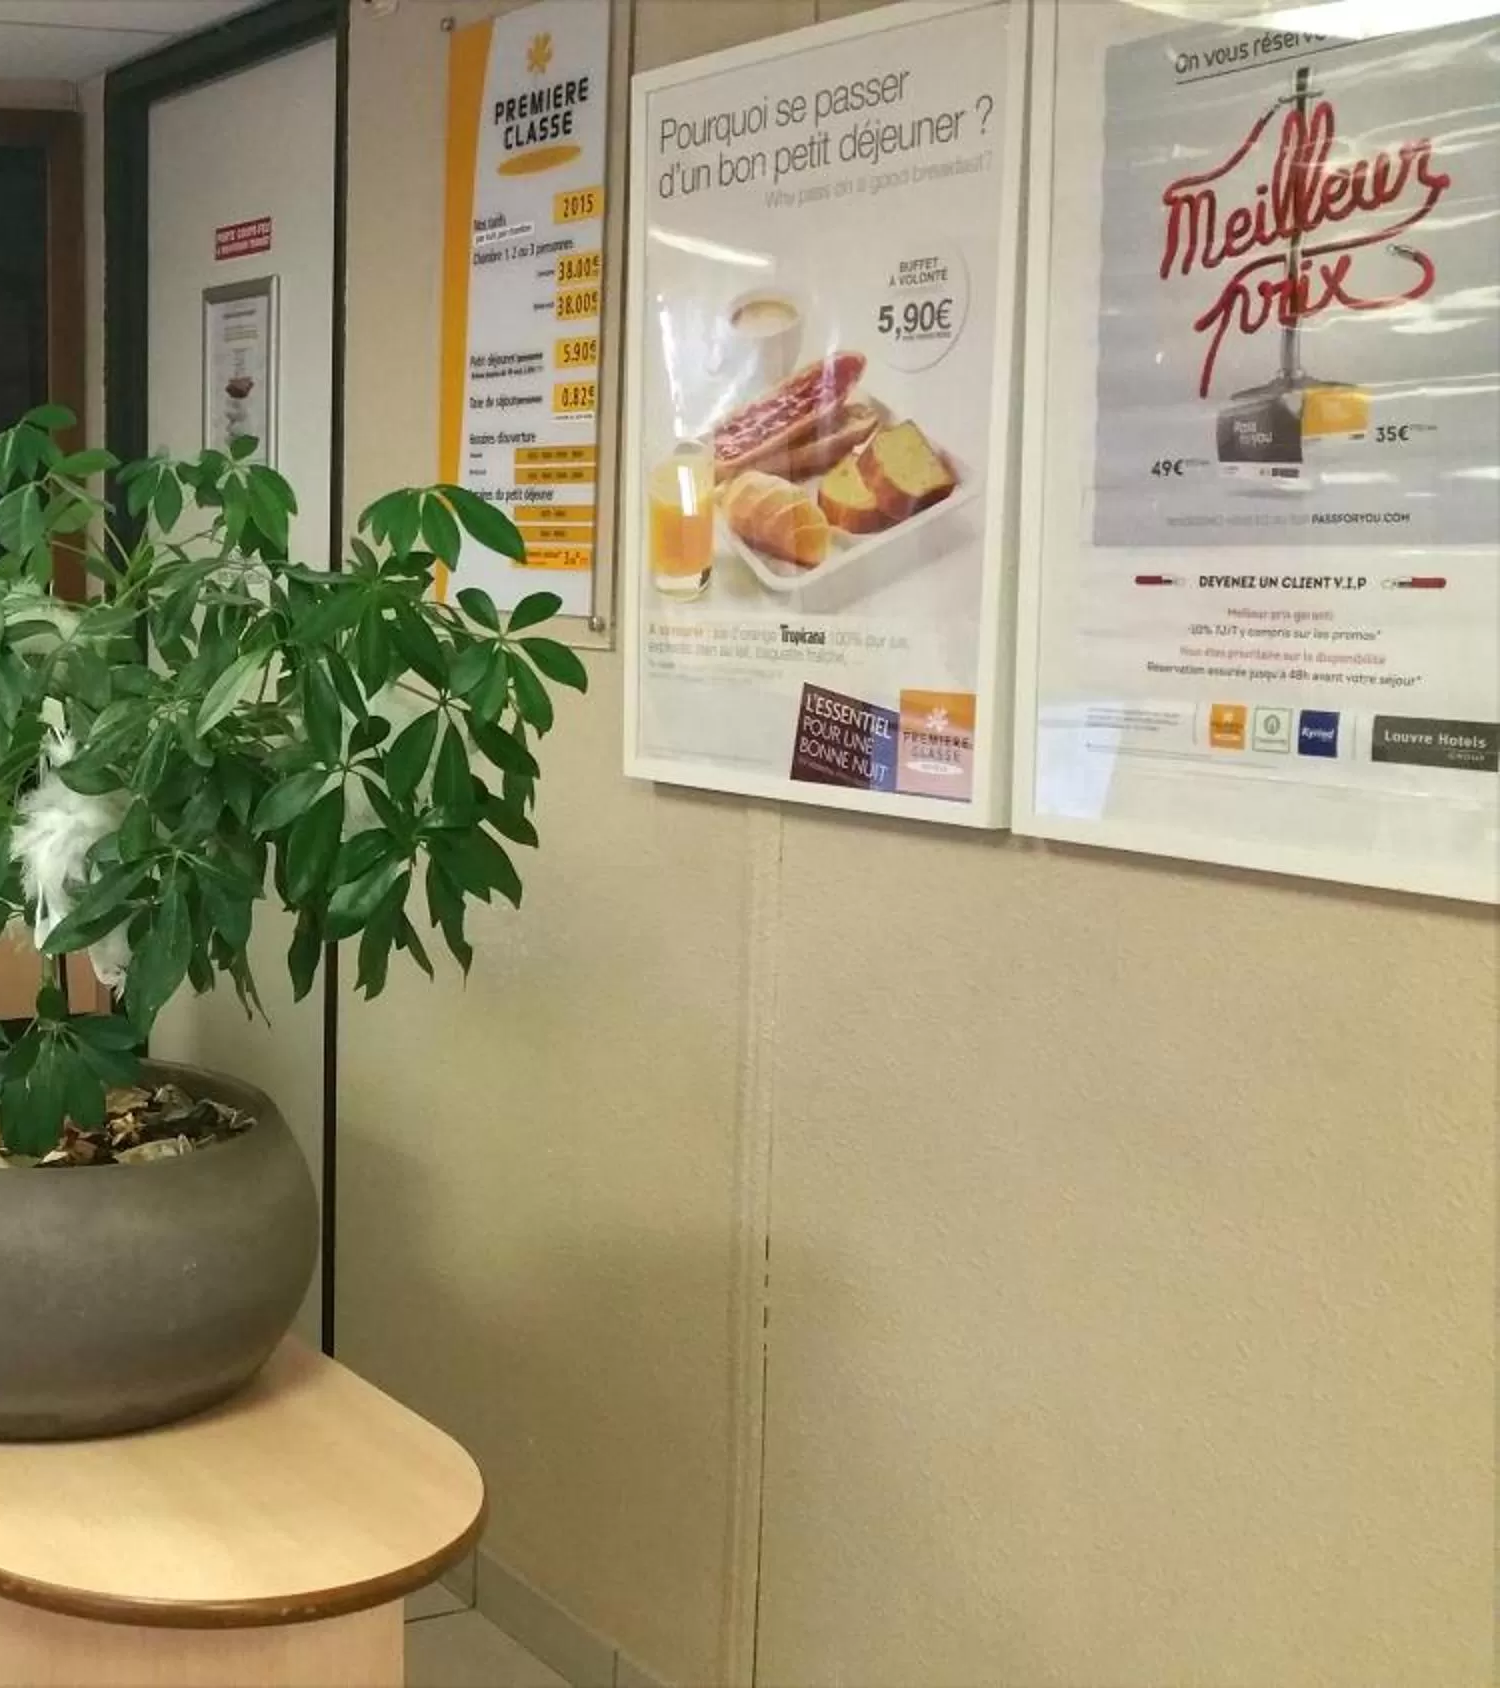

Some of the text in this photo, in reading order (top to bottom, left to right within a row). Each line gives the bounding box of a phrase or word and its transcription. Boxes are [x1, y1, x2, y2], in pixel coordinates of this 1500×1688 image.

[1175, 52, 1199, 74] On
[1203, 42, 1249, 67] vous
[494, 76, 590, 126] PREMIERE
[660, 69, 910, 154] Pourquoi se passer
[503, 111, 573, 150] CLASSE
[659, 94, 994, 199] d'un bon petit déjeuner ?
[563, 194, 594, 219] 2015
[1160, 101, 1450, 280] Meilleur
[877, 298, 953, 341] 5,90€
[1194, 253, 1430, 398] prix
[1376, 425, 1410, 443] 35€
[1151, 459, 1184, 476] 49€
[1199, 574, 1257, 588] DEVENEZ
[1259, 575, 1278, 588] UN
[1281, 575, 1332, 589] CLIENT
[780, 624, 826, 646] Tropicana
[805, 692, 892, 739] L'ESSENTIEL
[803, 716, 875, 754] POUR UNE
[903, 730, 971, 750] PREMIERE
[1384, 728, 1488, 749] Louvre Hotels
[799, 737, 849, 769] BONNE
[851, 756, 890, 784] NUIT
